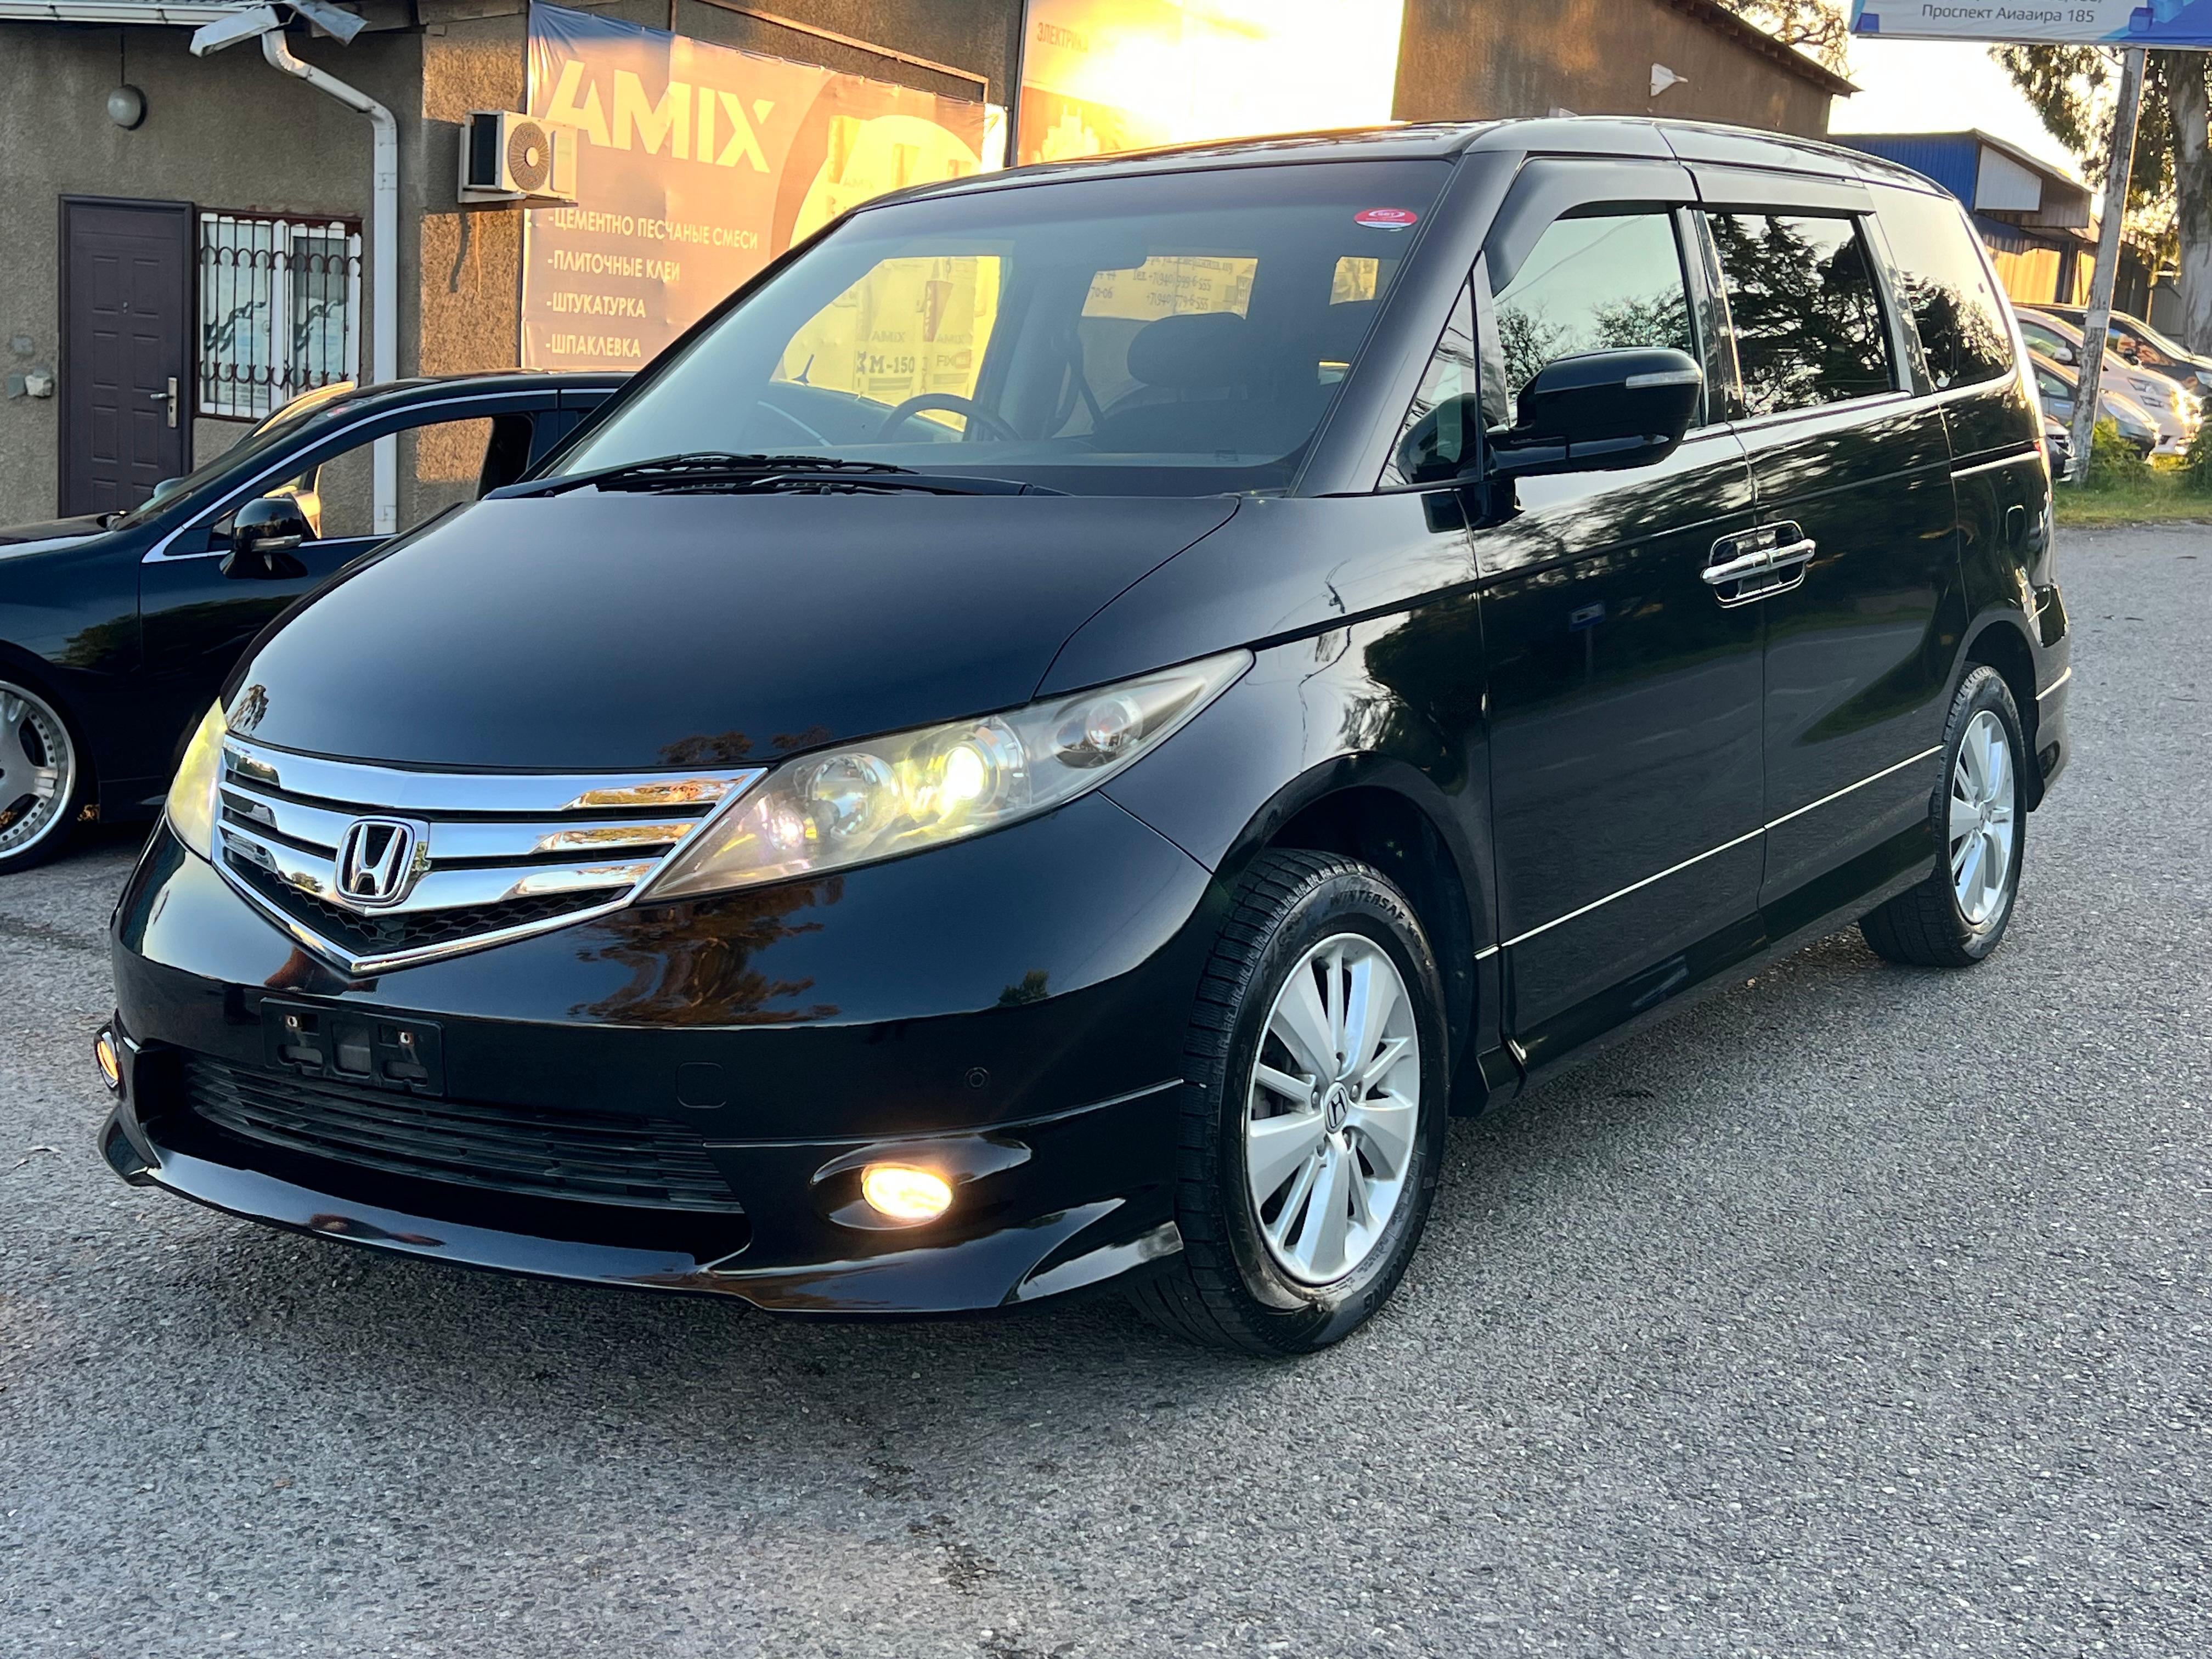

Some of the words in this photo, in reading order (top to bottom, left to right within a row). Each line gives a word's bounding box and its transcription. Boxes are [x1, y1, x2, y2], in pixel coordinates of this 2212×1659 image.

[1922, 5, 1994, 20] Проспект
[1995, 7, 2062, 24] Аиааира
[2067, 9, 2095, 22] 185
[544, 59, 775, 173] AMIX
[637, 217, 711, 245] ПЕСЧАНЫЕ
[713, 227, 758, 250] СМЕСИ
[646, 259, 681, 282] КЛЕИ
[871, 330, 906, 343] AMIX
[868, 356, 915, 374] M-150
